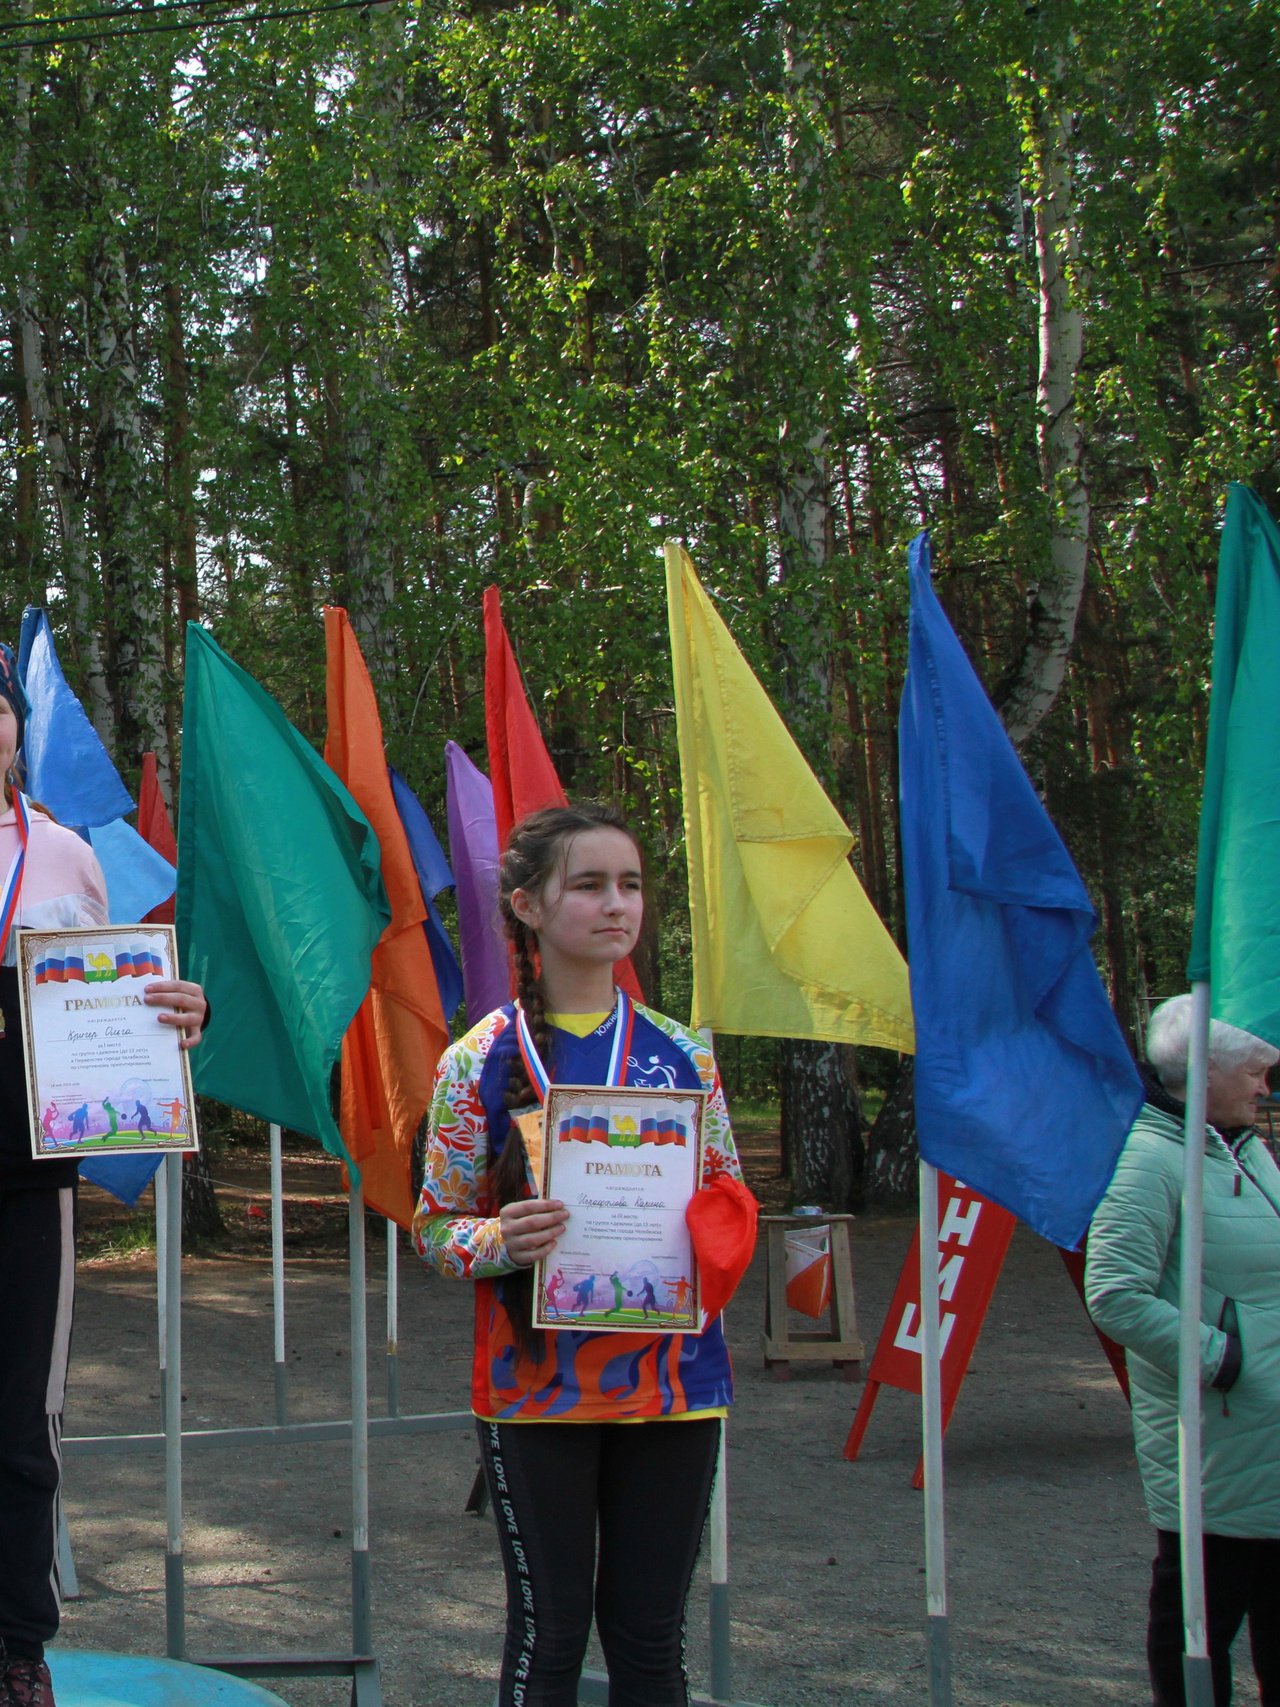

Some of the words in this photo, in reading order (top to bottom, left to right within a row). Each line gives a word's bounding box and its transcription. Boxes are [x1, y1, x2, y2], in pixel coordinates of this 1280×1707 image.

[64, 995, 143, 1011] ГРАМОТА
[105, 1026, 134, 1036] Ольга
[585, 1162, 663, 1177] ГРАМОТА
[493, 1456, 509, 1493] LOVE
[501, 1498, 519, 1535] LOVE
[511, 1540, 529, 1575] LOVE
[520, 1578, 535, 1613] LOVE
[523, 1616, 537, 1651] LOVE
